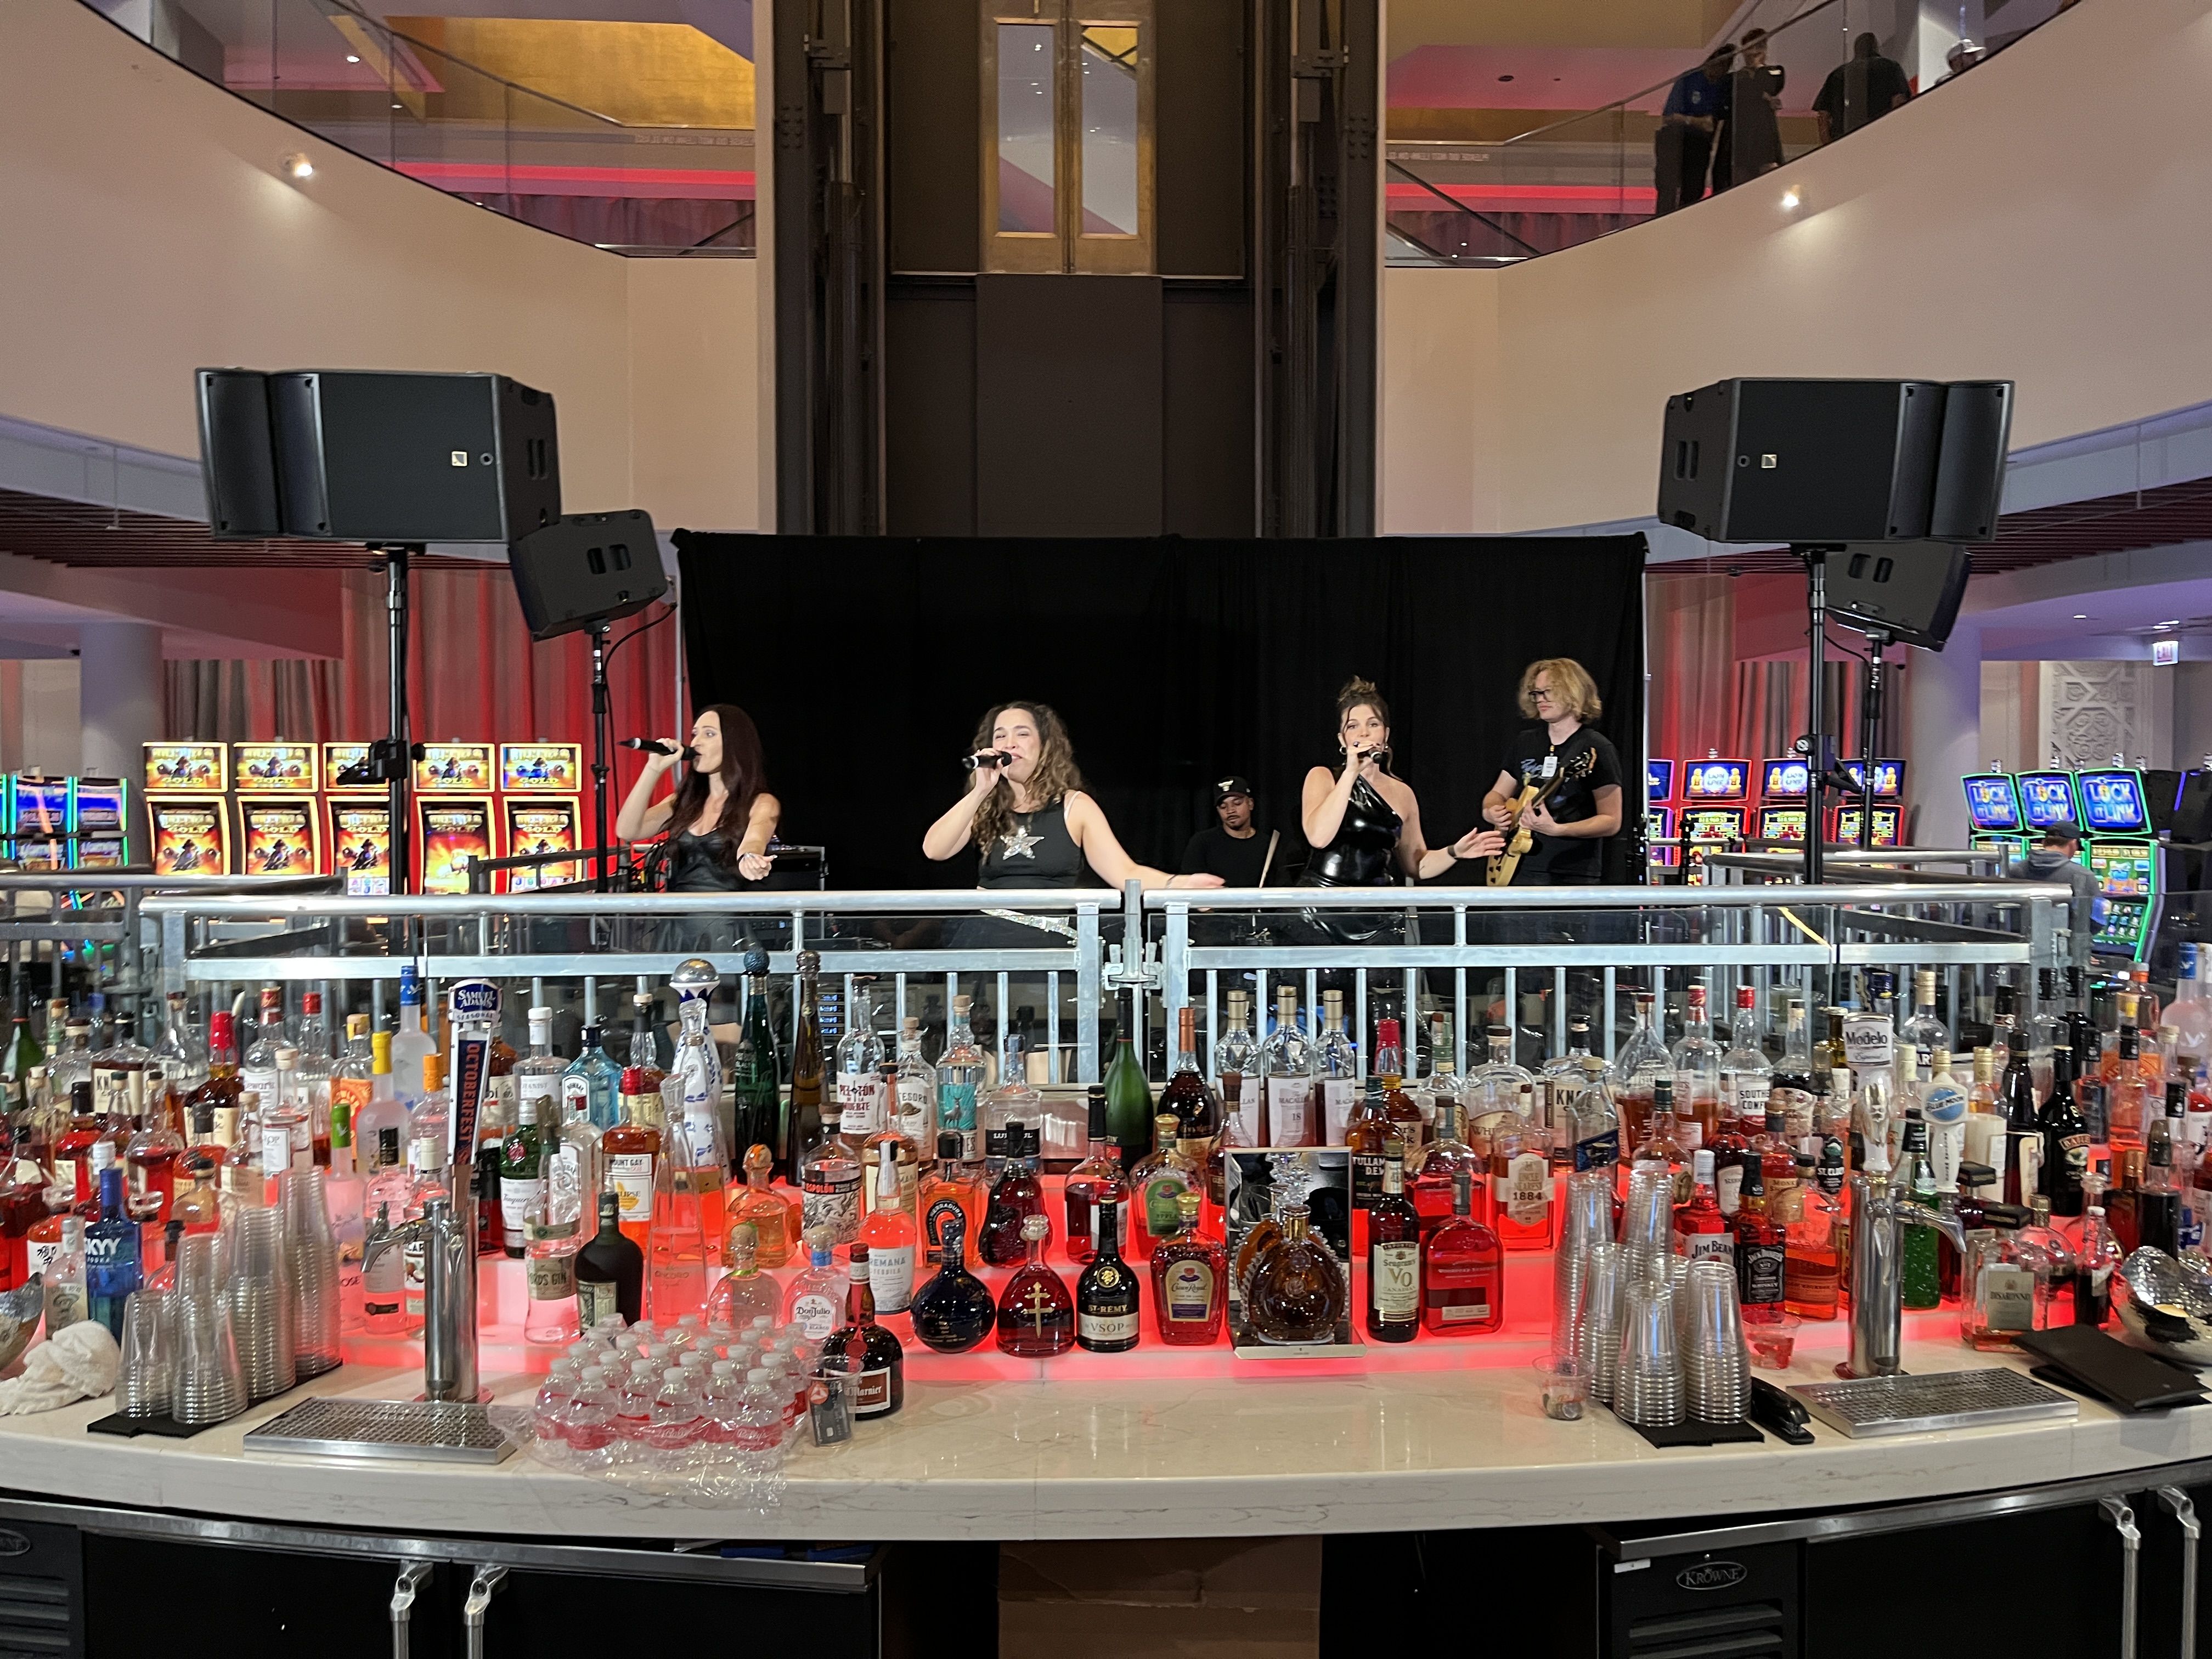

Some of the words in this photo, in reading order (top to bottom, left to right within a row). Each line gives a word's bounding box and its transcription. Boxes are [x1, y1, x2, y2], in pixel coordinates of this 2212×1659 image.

[1973, 786, 2006, 803] LOCK
[2029, 785, 2067, 802] LOCK
[2089, 783, 2131, 802] LOCK
[1985, 803, 2013, 821] LINK
[2041, 803, 2069, 821] LINK
[2103, 802, 2137, 822] LINK
[458, 989, 496, 1001] SAMUEL
[460, 998, 493, 1009] ADAMS
[1846, 1031, 1888, 1045] Modelo
[97, 1075, 110, 1091] KN
[460, 1043, 481, 1148] OCTOBERFEST
[1556, 1089, 1583, 1105] KN
[1740, 1090, 1770, 1098] SOUTHE
[1742, 1101, 1765, 1109] COMF
[1926, 1102, 1944, 1113] BLUE
[1945, 1095, 1964, 1105] MOON
[1292, 1113, 1301, 1121] 18
[630, 1158, 643, 1166] GAY
[1352, 1156, 1386, 1165] TULLAM
[1513, 1192, 1543, 1200] 1884
[1692, 1244, 1709, 1259] JIM
[869, 1256, 906, 1267] REMANA
[551, 1272, 567, 1285] GIN
[1388, 1267, 1412, 1287] VO
[1171, 1283, 1188, 1293] Crown
[796, 1306, 812, 1316] Don
[812, 1307, 830, 1317] Julio
[1090, 1322, 1124, 1333] VSOP
[1685, 1567, 1741, 1586] KROWNE
